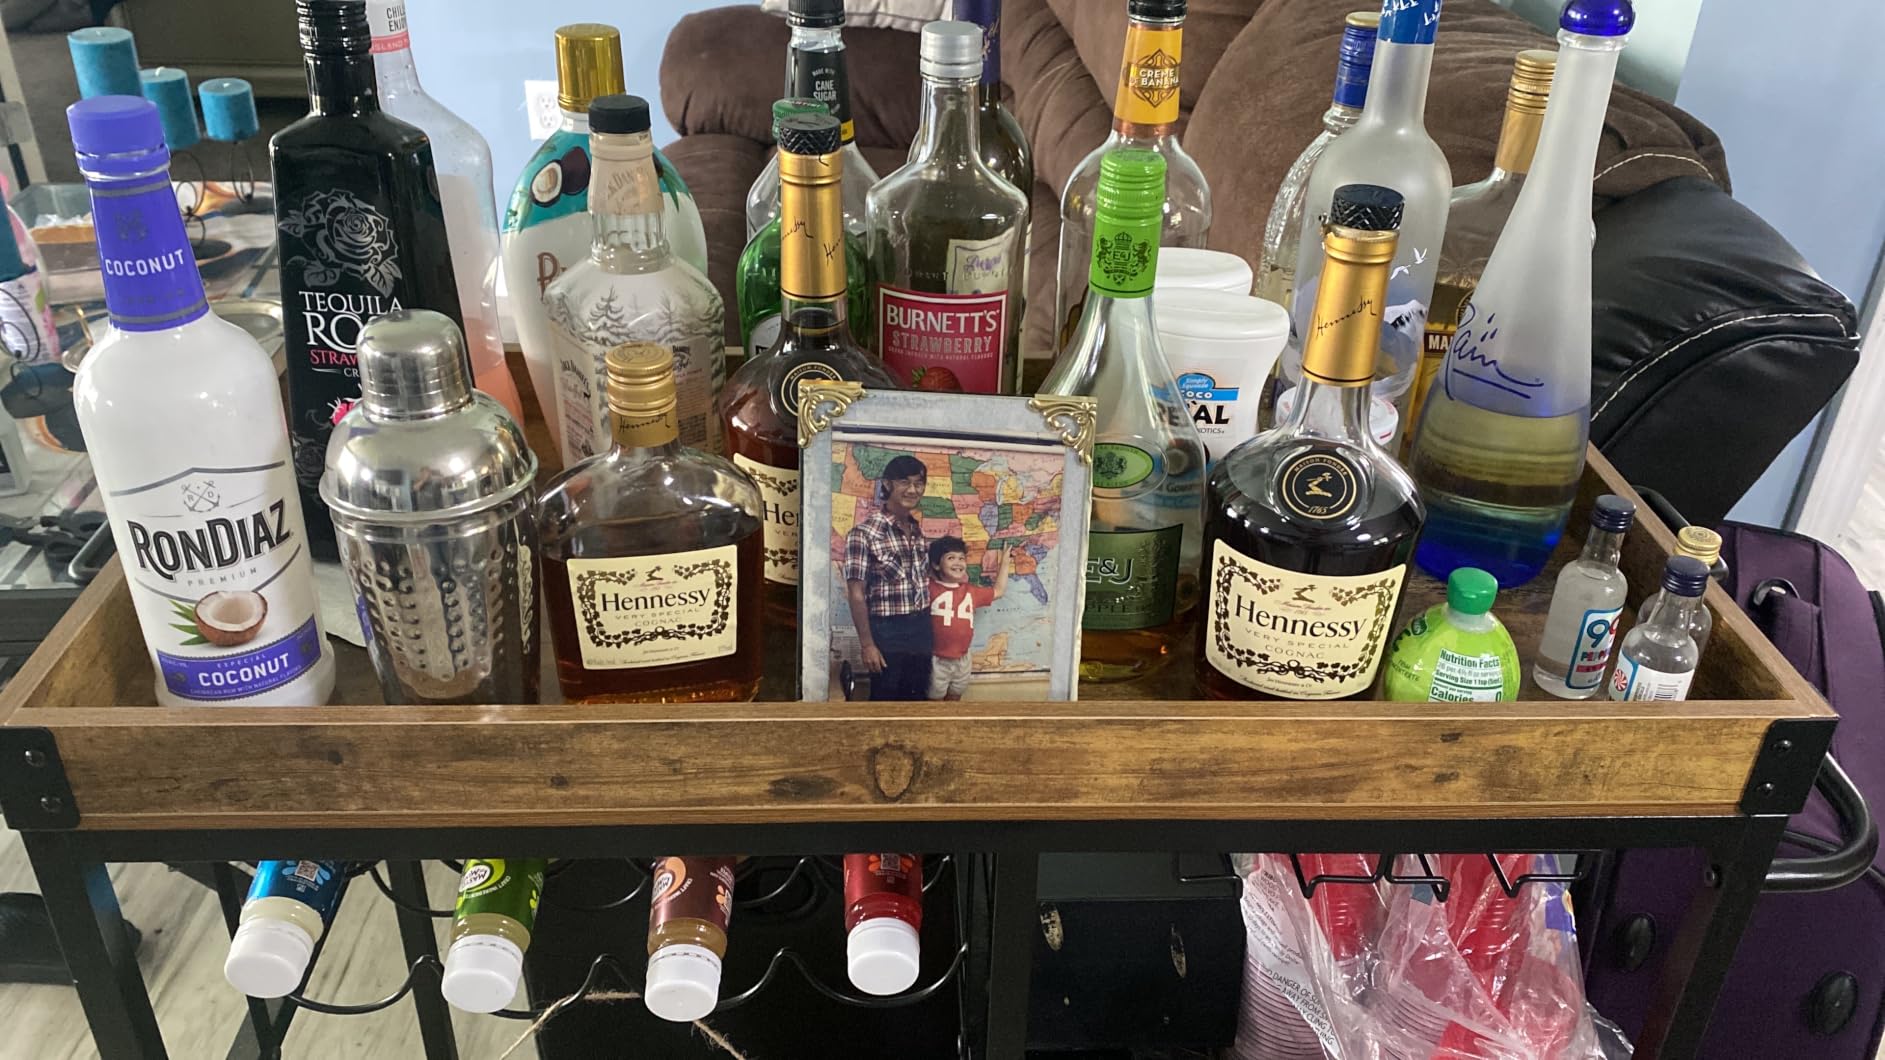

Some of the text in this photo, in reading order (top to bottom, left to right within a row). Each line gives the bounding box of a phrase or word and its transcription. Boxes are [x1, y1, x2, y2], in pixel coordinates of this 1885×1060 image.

[815, 80, 834, 90] CANE
[813, 91, 836, 101] SUGAR
[105, 248, 184, 276] COCONUT
[298, 291, 403, 318] TEQUILA
[886, 303, 999, 334] BURNETT'S
[302, 312, 377, 354] RO
[892, 330, 992, 354] STRAWBERRY
[1428, 334, 1454, 350] MA
[1308, 505, 1329, 514] 1765
[775, 529, 798, 537] VER
[187, 566, 258, 587] PREMIUM
[601, 588, 711, 612] Hennessy
[930, 590, 974, 629] 44
[635, 617, 682, 627] COGNAC
[651, 608, 700, 618] SPECIAL
[1235, 594, 1367, 640] Hennessy
[1244, 627, 1350, 649] VERY SPECIAL
[1265, 644, 1325, 659] COGNAC
[1440, 649, 1500, 668] Nutrition Facts
[198, 652, 290, 687] COCONUT
[1435, 669, 1459, 683] Serving
[1460, 676, 1472, 685] Size
[1431, 686, 1502, 702] Calories 0
[1272, 972, 1301, 992] DANGER
[1300, 988, 1312, 998] OF
[1282, 987, 1300, 1002] AWAY
[1300, 999, 1321, 1016] FROM
[1306, 1013, 1328, 1030] CLING
